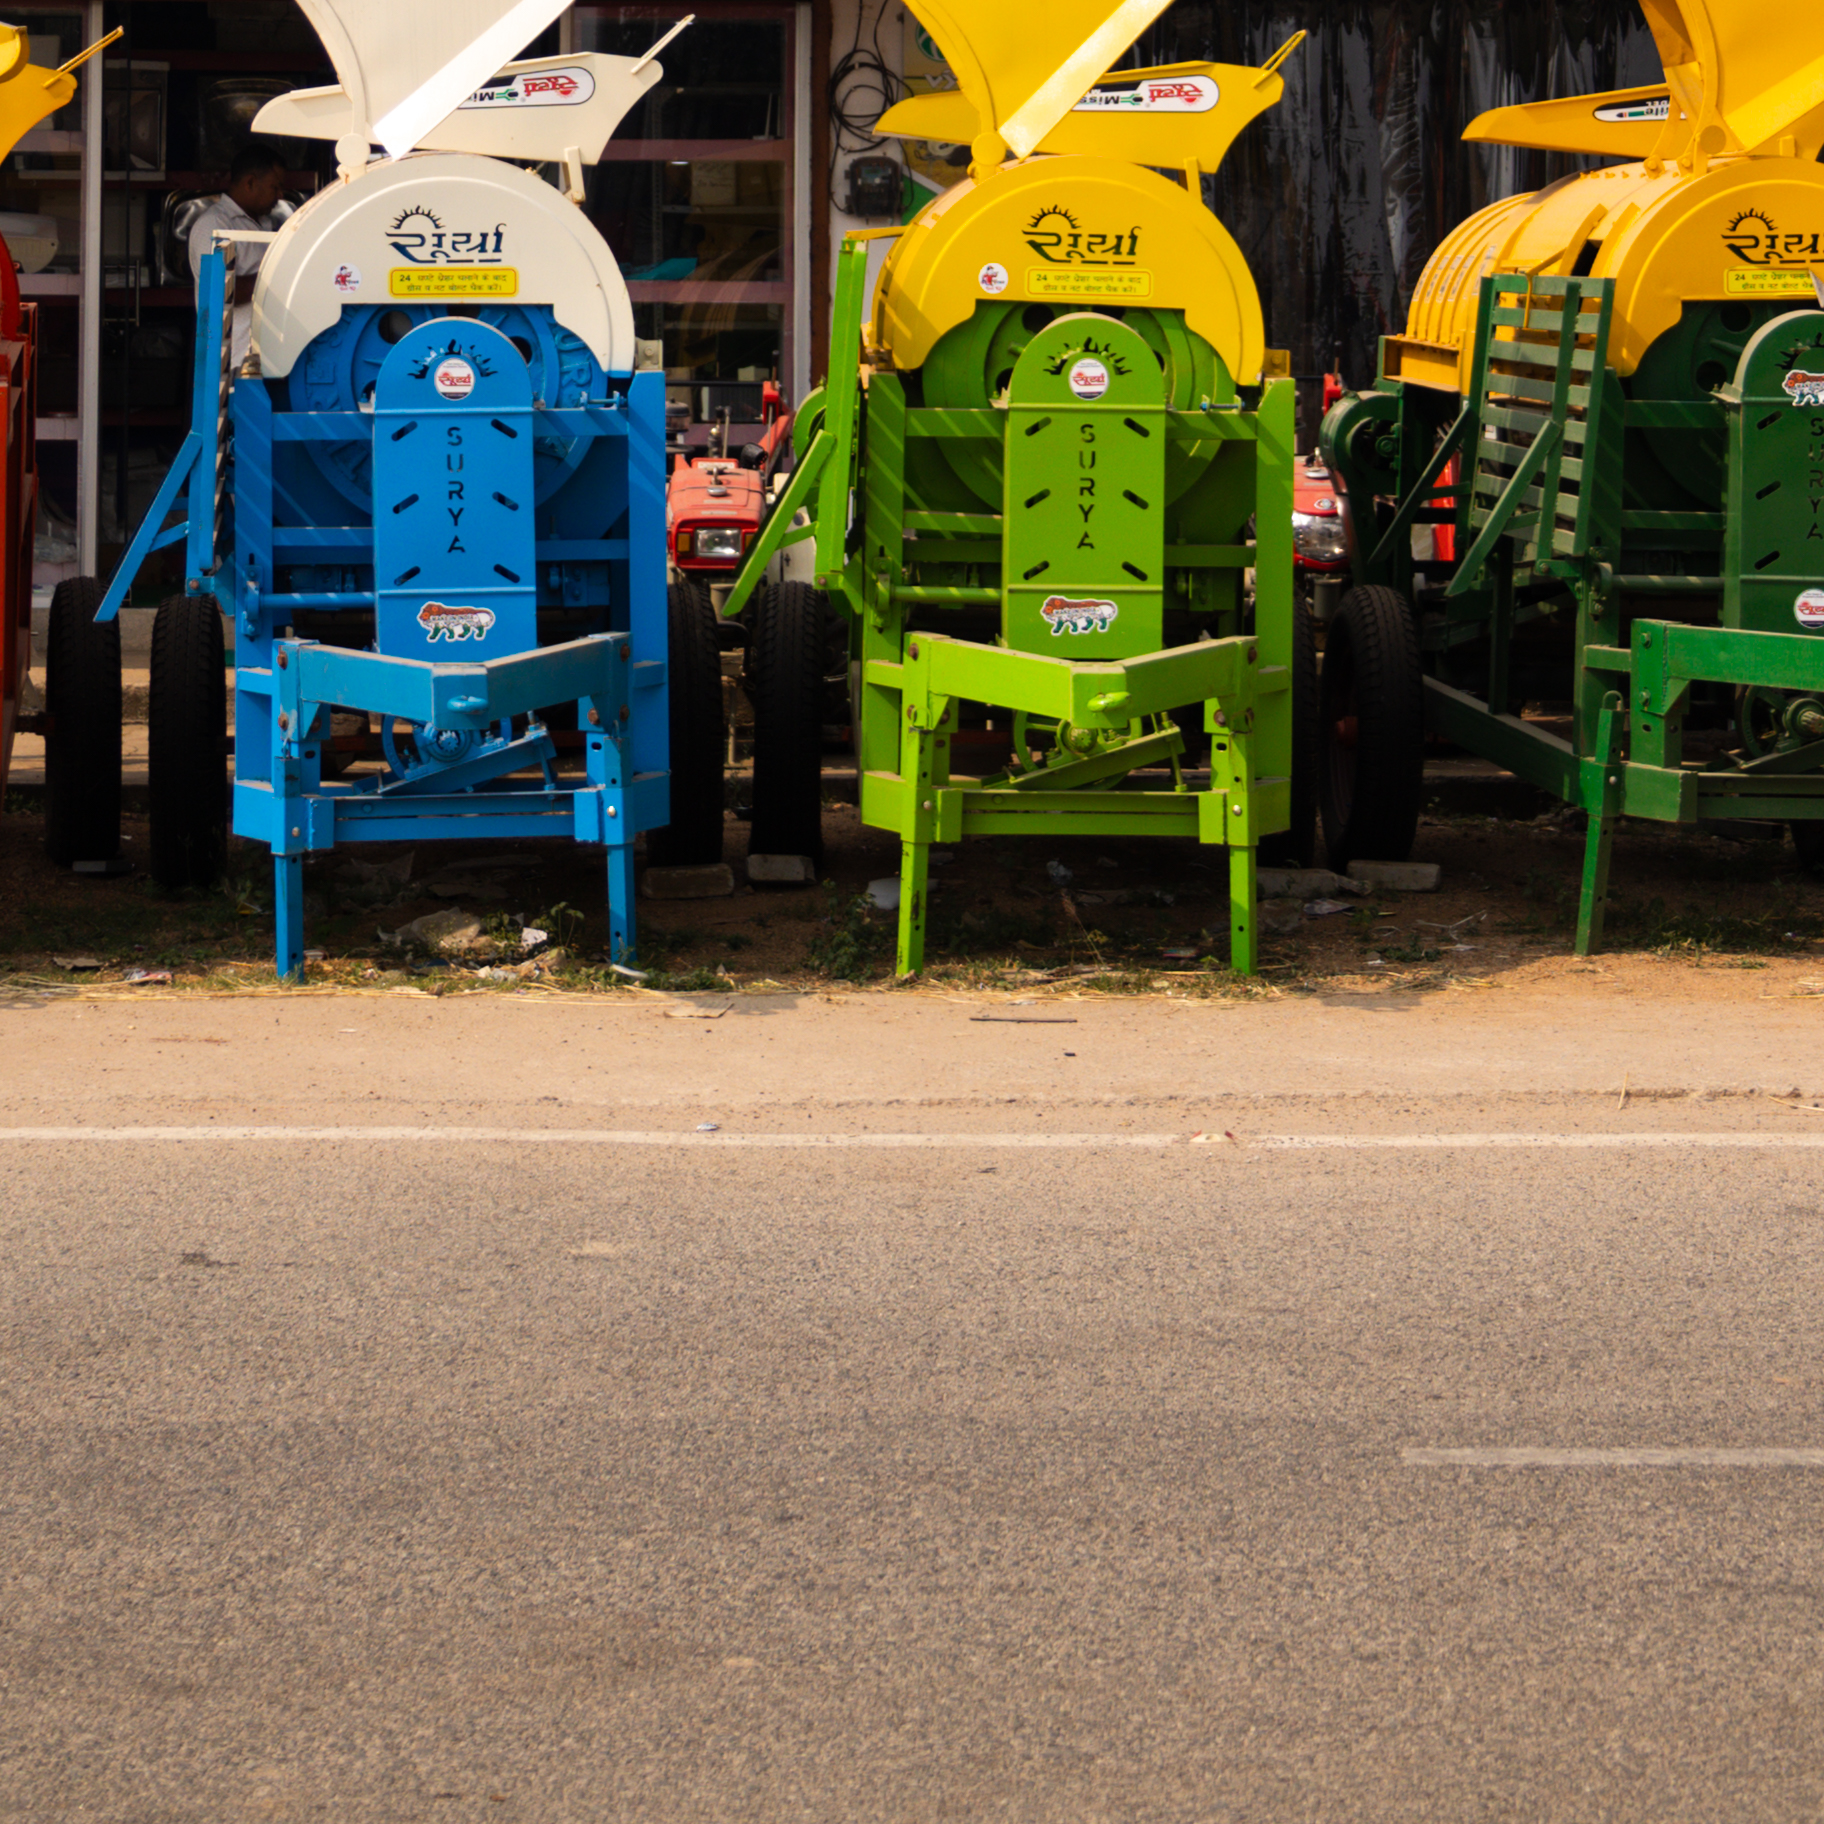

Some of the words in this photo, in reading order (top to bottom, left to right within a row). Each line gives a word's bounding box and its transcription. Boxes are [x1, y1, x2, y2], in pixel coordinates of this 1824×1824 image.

[399, 274, 411, 282] 24
[446, 426, 466, 554] SURYA
[1076, 423, 1096, 550] SURYA
[1805, 416, 1824, 541] SURYA
